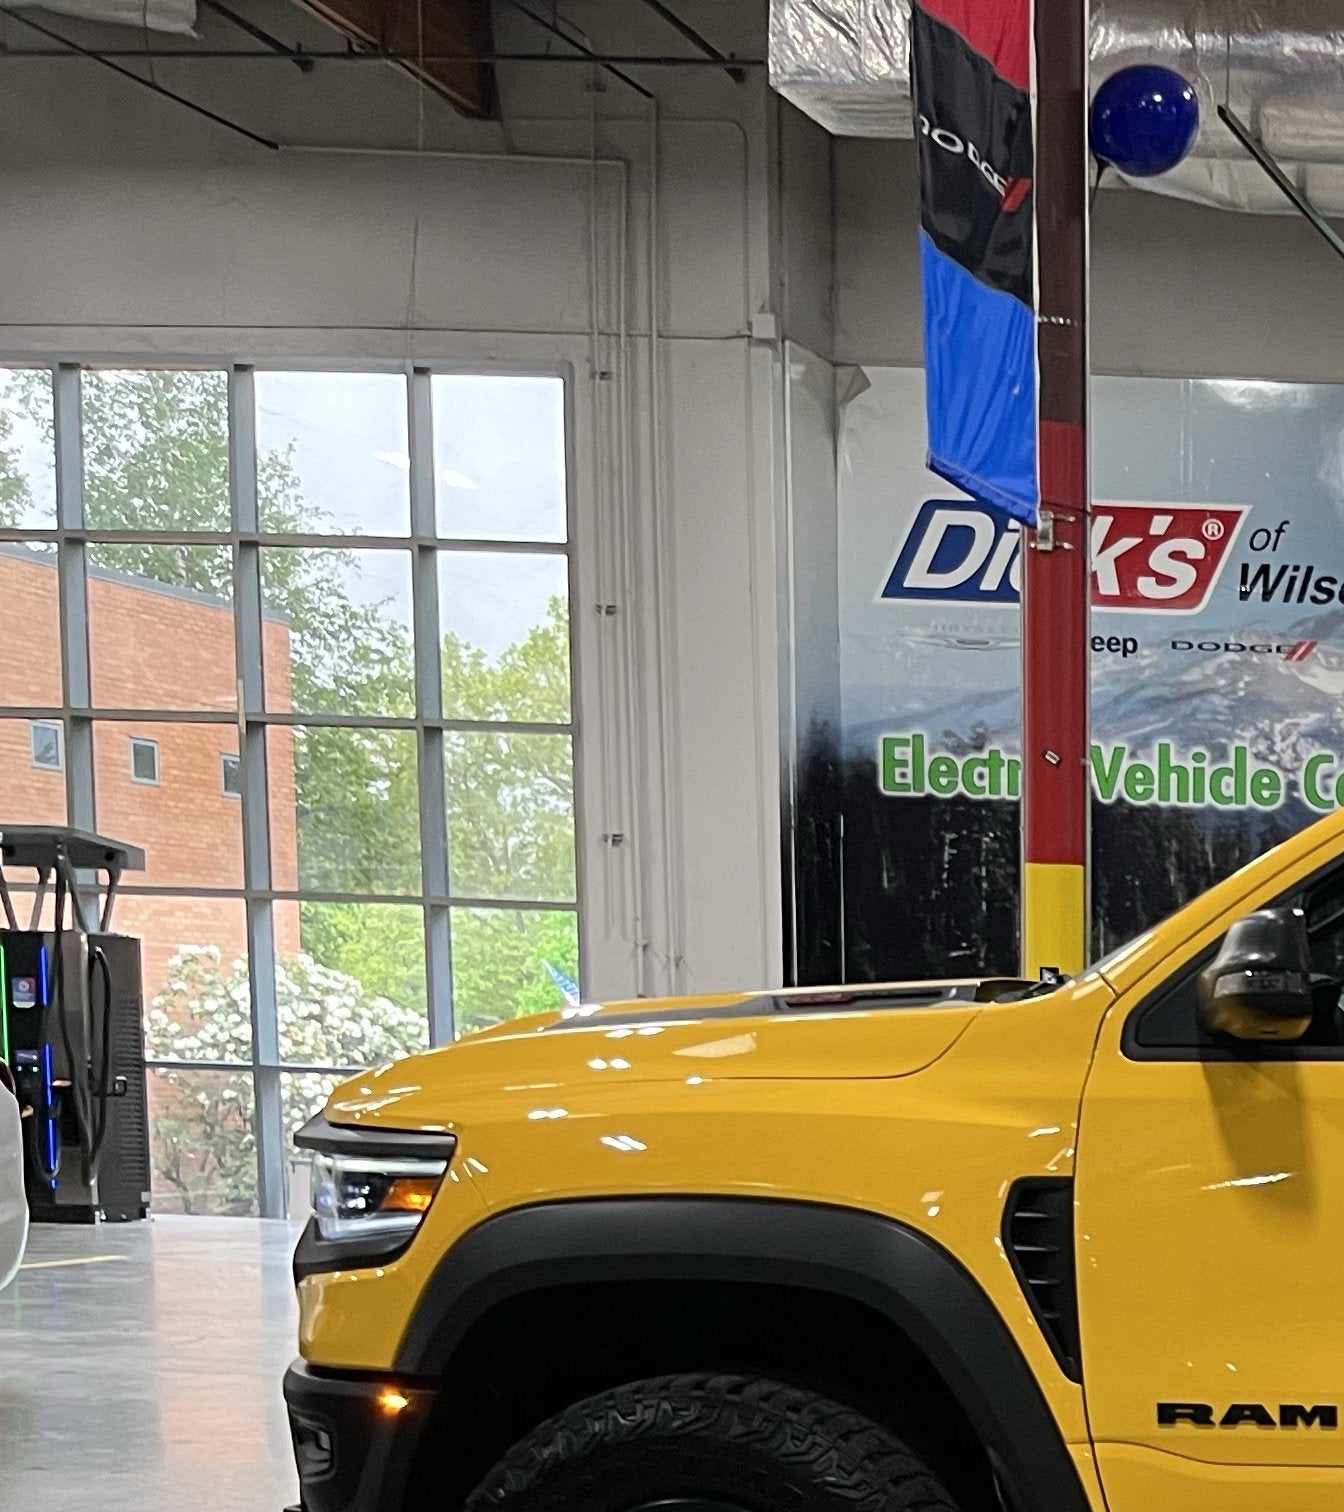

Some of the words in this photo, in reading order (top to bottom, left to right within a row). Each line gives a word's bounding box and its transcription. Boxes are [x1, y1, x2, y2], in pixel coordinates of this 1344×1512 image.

[1250, 520, 1290, 552] of
[1091, 635, 1139, 657] eep
[882, 733, 1022, 797] Electr
[1090, 742, 1282, 807] Vehicle
[1157, 1402, 1338, 1429] RAM
